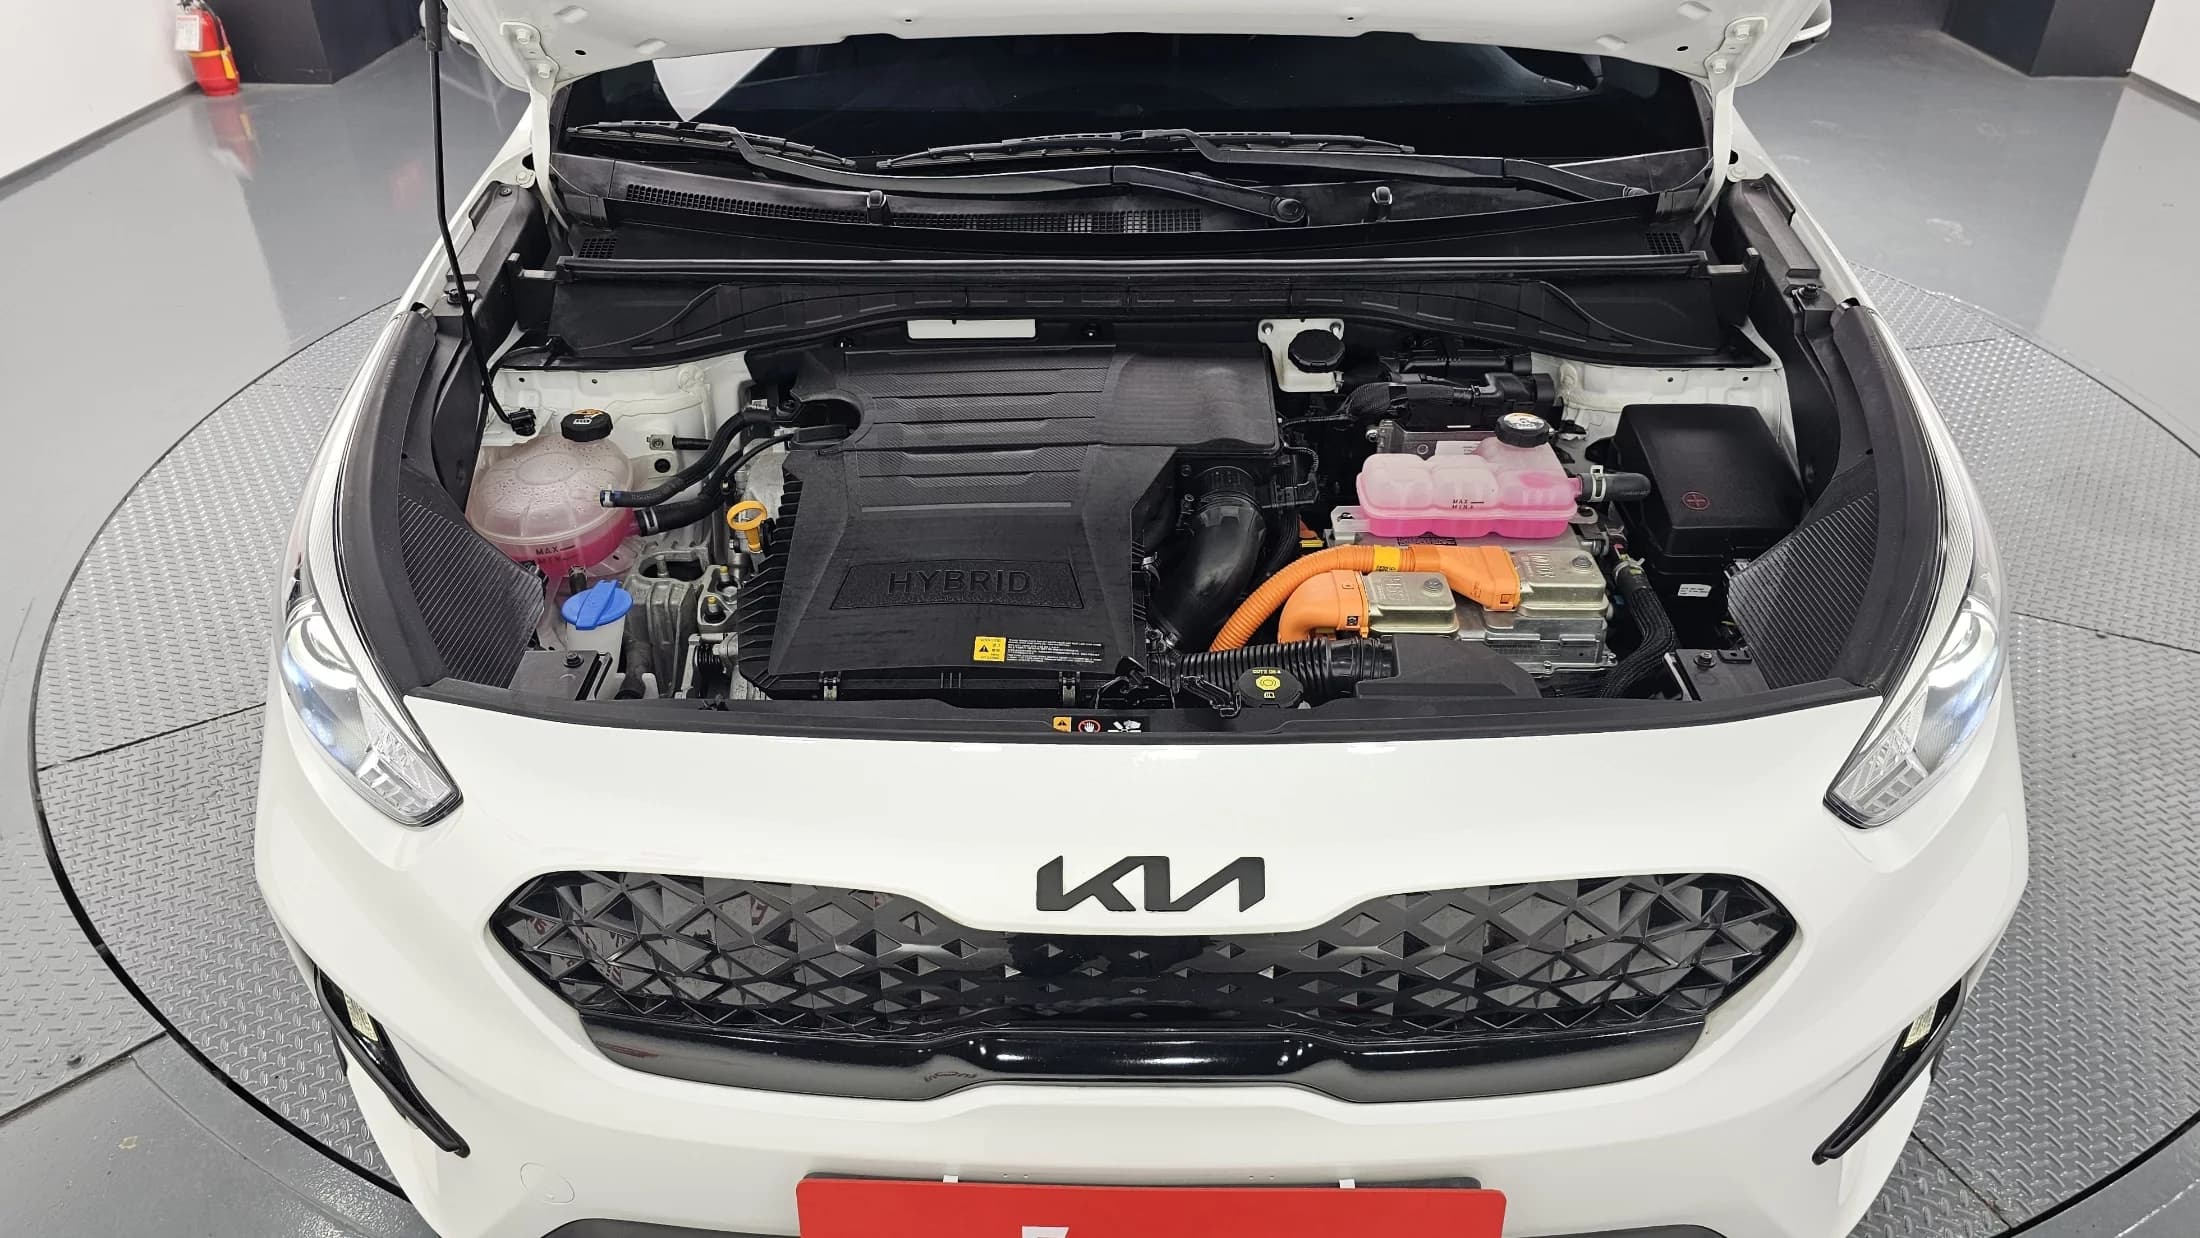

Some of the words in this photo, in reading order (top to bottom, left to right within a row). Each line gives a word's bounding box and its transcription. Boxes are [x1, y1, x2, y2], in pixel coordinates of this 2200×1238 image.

[535, 545, 559, 555] MAX
[887, 569, 1031, 594] HYBRID
[1036, 855, 1266, 912] KIA
